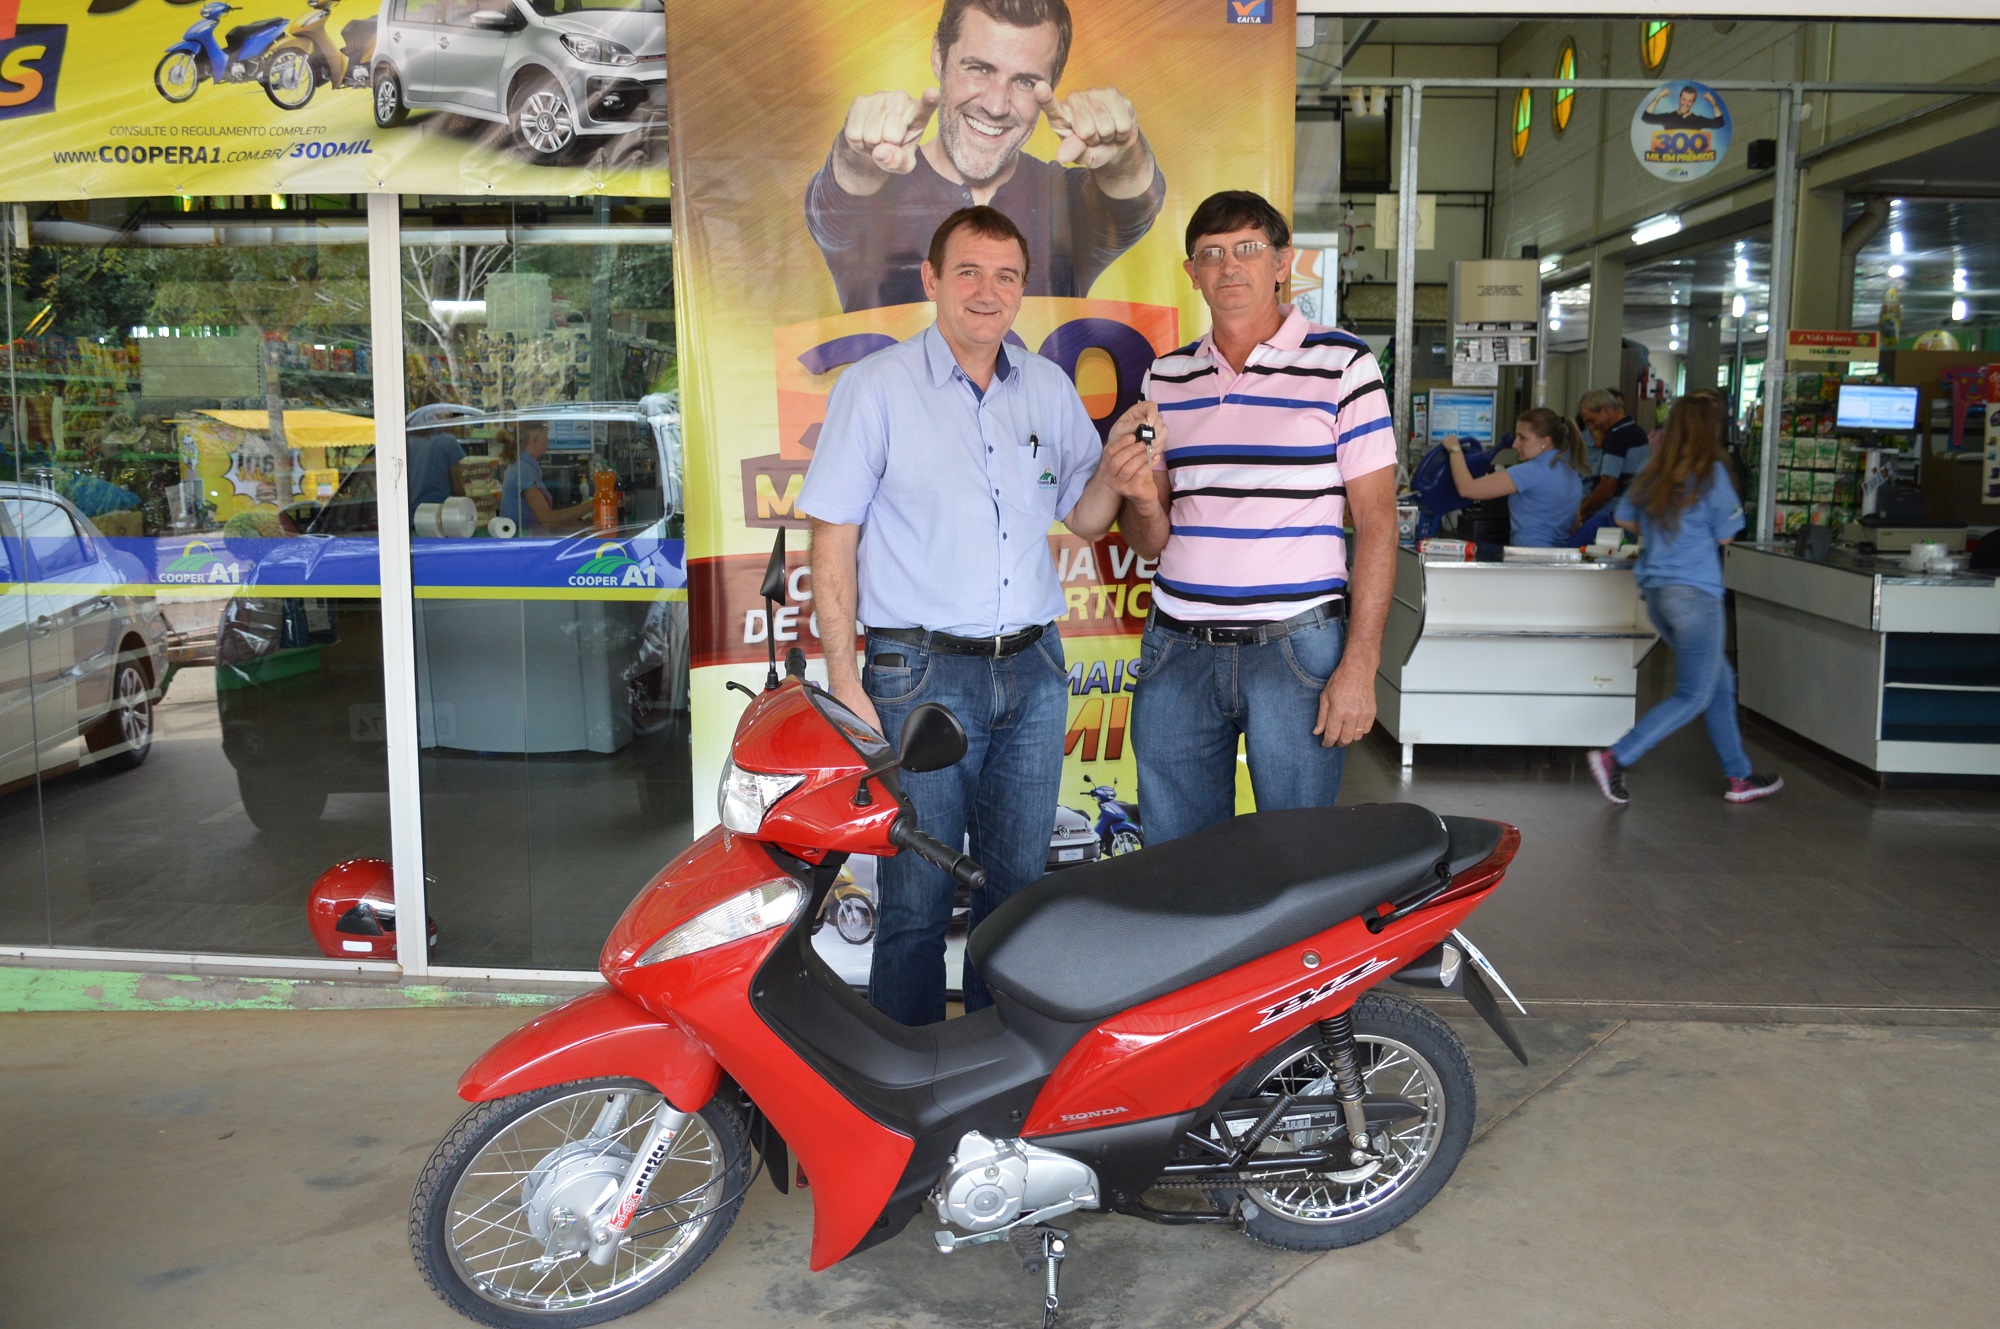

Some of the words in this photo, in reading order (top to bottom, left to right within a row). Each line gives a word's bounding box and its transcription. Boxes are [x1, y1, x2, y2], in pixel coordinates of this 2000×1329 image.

[1237, 16, 1261, 24] CAIXA
[109, 126, 167, 137] CONSULTE
[169, 126, 179, 137] O
[181, 126, 267, 137] REGULAMENTO
[269, 125, 327, 137] COMPLETO
[1654, 132, 1709, 154] 300
[1646, 152, 1661, 161] MIL
[1662, 153, 1676, 162] EM
[158, 573, 205, 583] COOPER
[207, 562, 240, 583] A1
[1108, 545, 1160, 580] VE
[568, 575, 618, 586] COOPER
[620, 564, 656, 587] A1
[743, 606, 800, 643] DE
[1060, 1106, 1129, 1122] HONDA
